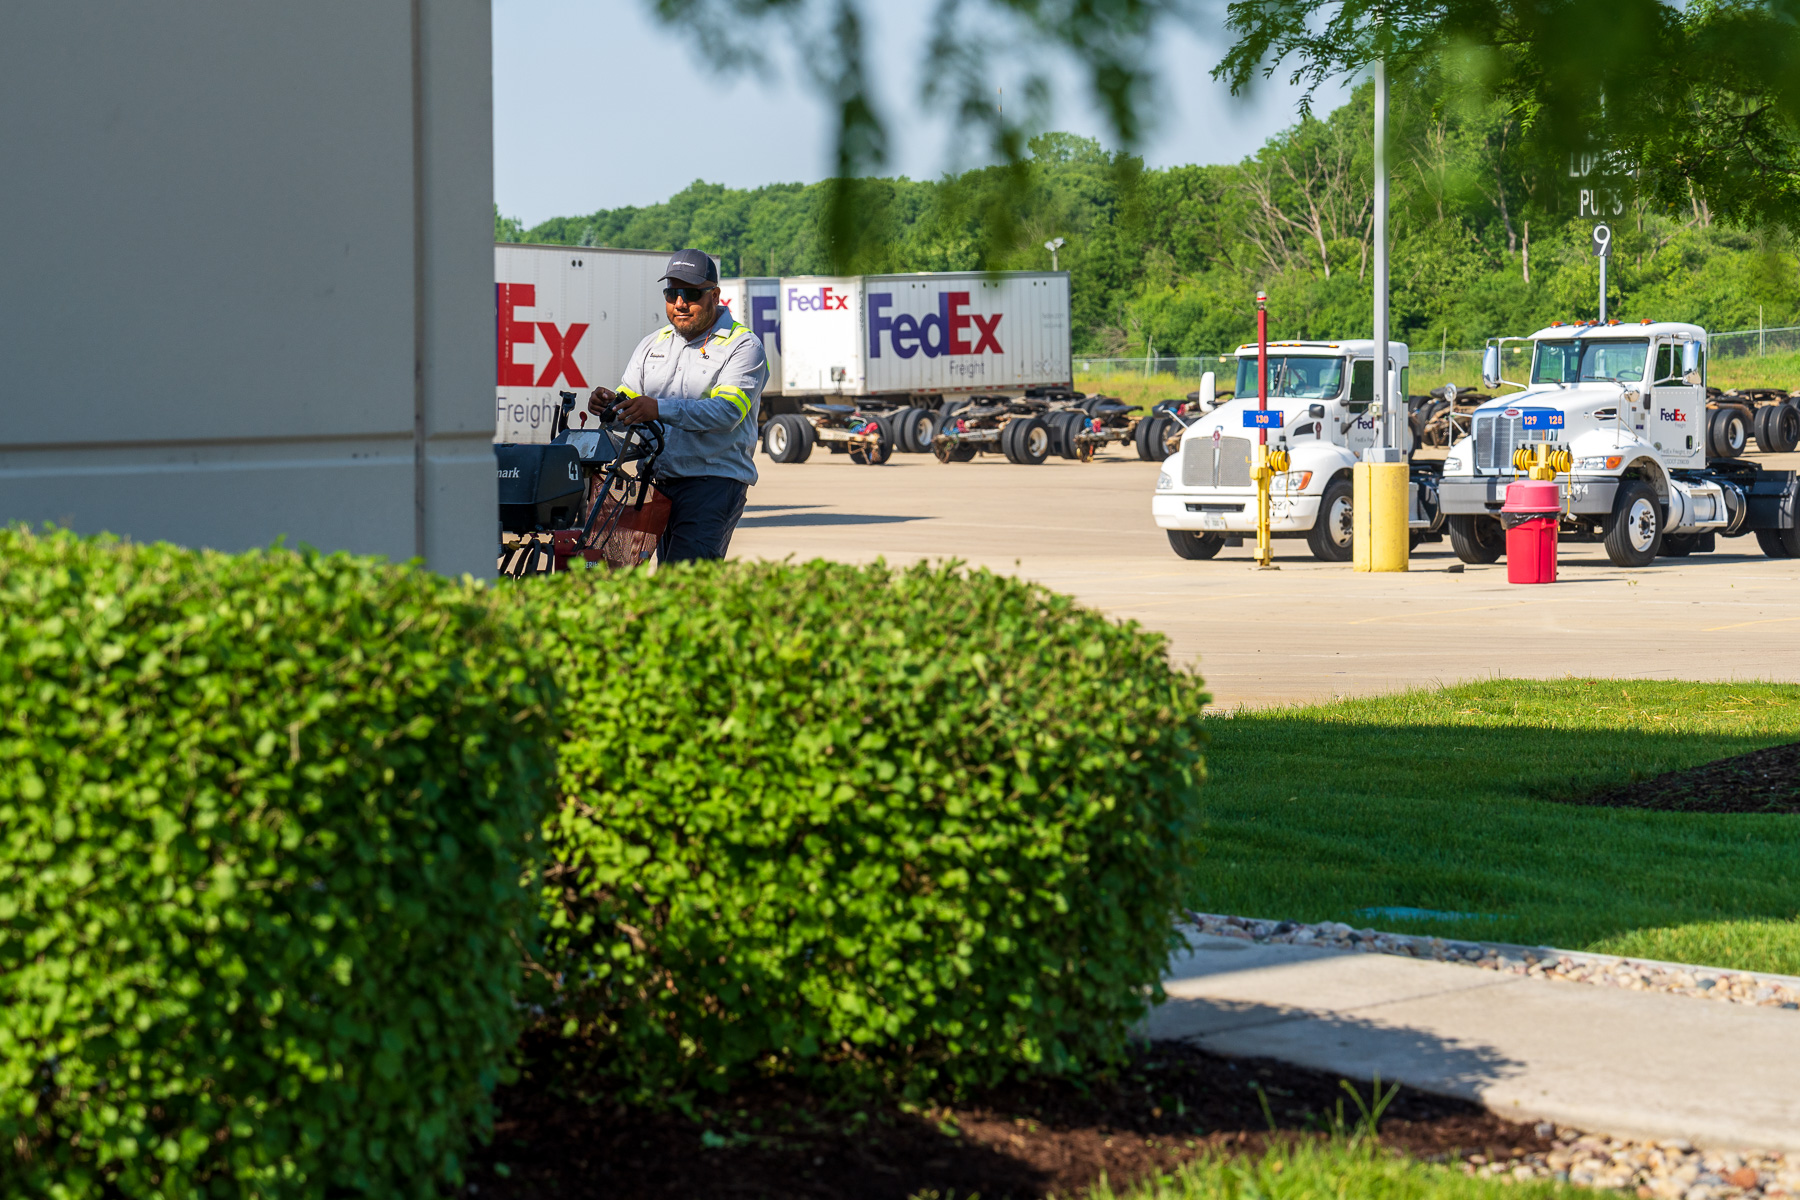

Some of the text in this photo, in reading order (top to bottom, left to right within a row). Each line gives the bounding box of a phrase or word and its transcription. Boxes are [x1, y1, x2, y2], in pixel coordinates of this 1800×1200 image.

[1593, 225, 1611, 256] 9
[788, 287, 848, 311] FedEx
[868, 291, 1004, 360] FedEx
[496, 282, 590, 388] Ex
[950, 360, 985, 378] Freight
[1256, 415, 1269, 424] 130
[1357, 416, 1374, 429] Fed
[1524, 415, 1563, 425] 129 128
[1661, 408, 1686, 422] FedEx
[568, 461, 579, 480] 4
